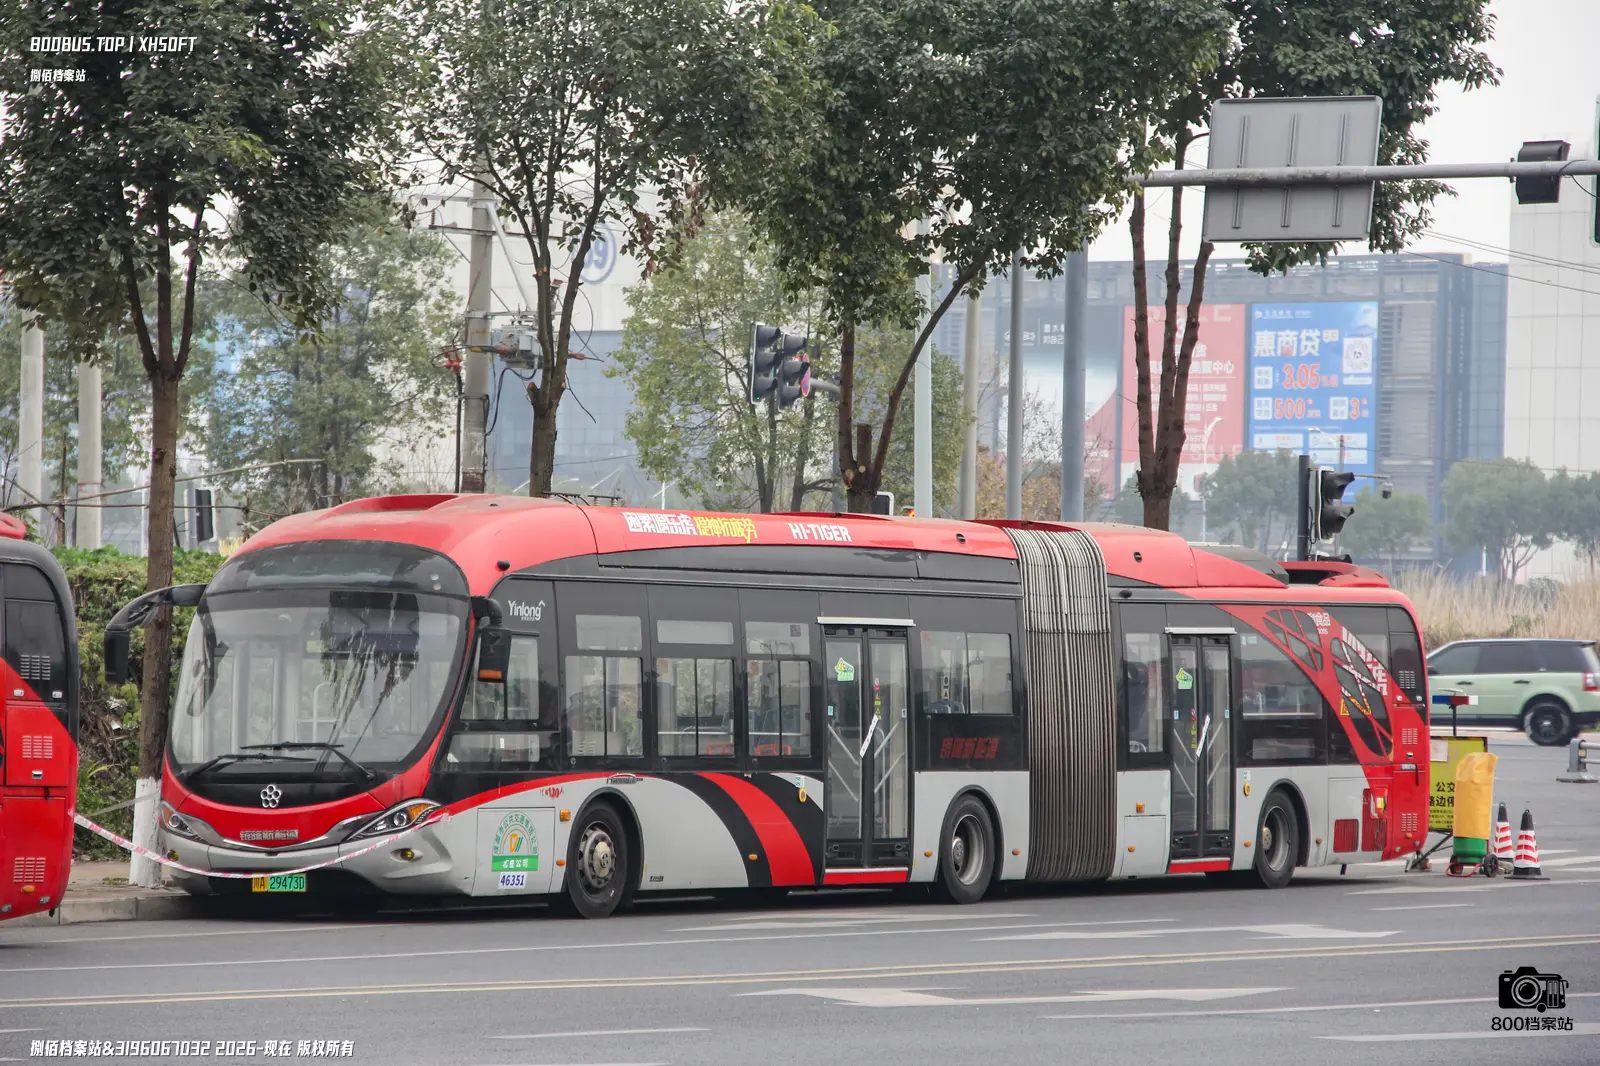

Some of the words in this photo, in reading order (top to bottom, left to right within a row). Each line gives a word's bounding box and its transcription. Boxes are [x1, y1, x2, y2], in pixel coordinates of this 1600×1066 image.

[1254, 329, 1321, 357] 惠商贷
[508, 600, 541, 621] Yinlong
[269, 876, 306, 890] 29473D
[500, 875, 525, 887] 46351
